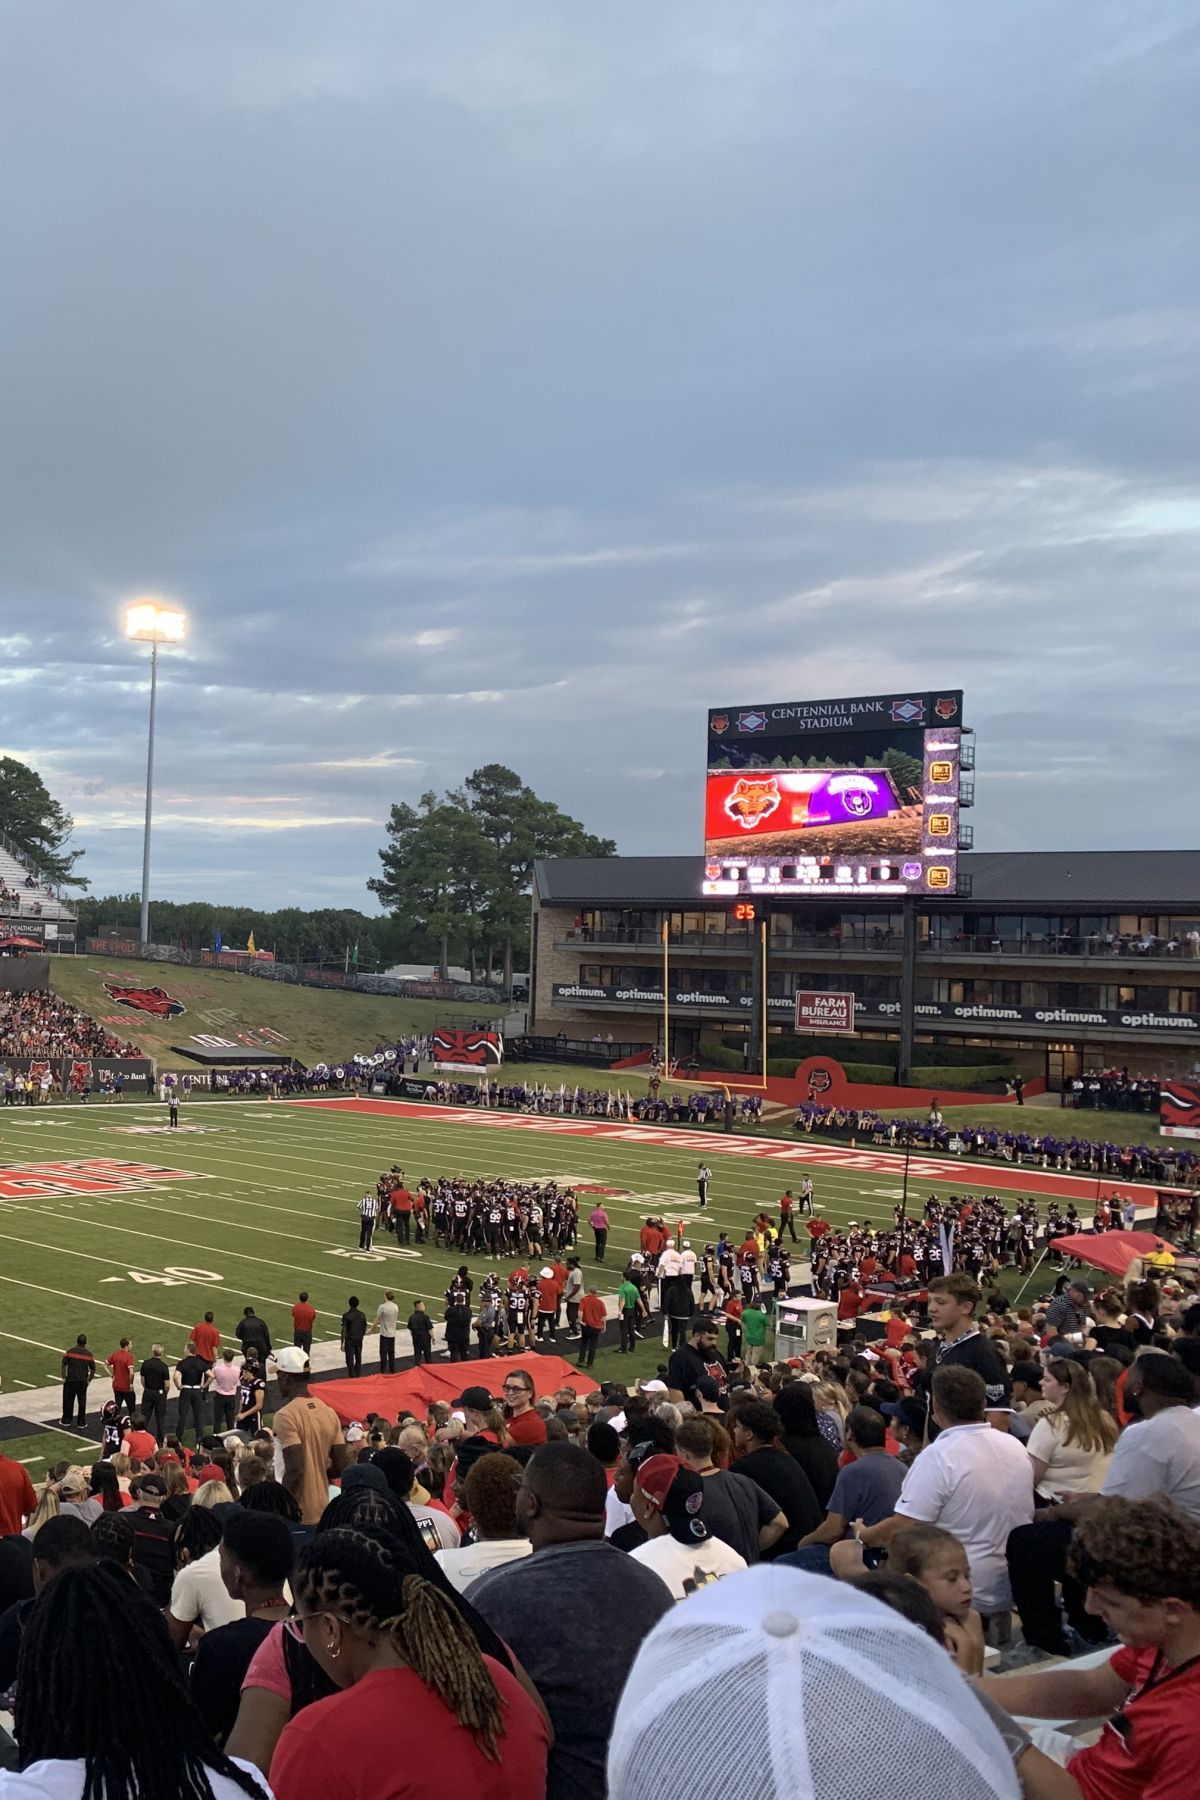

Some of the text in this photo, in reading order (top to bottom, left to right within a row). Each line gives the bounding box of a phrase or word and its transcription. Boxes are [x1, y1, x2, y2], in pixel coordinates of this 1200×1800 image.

[772, 701, 884, 720] CENTENNIAL BANK
[800, 717, 853, 729] STADIUM
[736, 905, 756, 919] 25
[558, 986, 606, 998] optimum.
[676, 991, 729, 1004] optimum.
[815, 997, 846, 1008] FARM
[801, 1006, 847, 1018] BUREAU
[954, 1005, 1022, 1019] optimum.
[1035, 1009, 1107, 1024] optimum.
[809, 1019, 847, 1027] INSURANCE
[1121, 1012, 1198, 1029] optimum.
[593, 1125, 967, 1177] WOLVES
[433, 1203, 445, 1214] 37
[323, 1245, 423, 1262] 50
[126, 1266, 224, 1287] 40
[509, 1297, 526, 1310] 38
